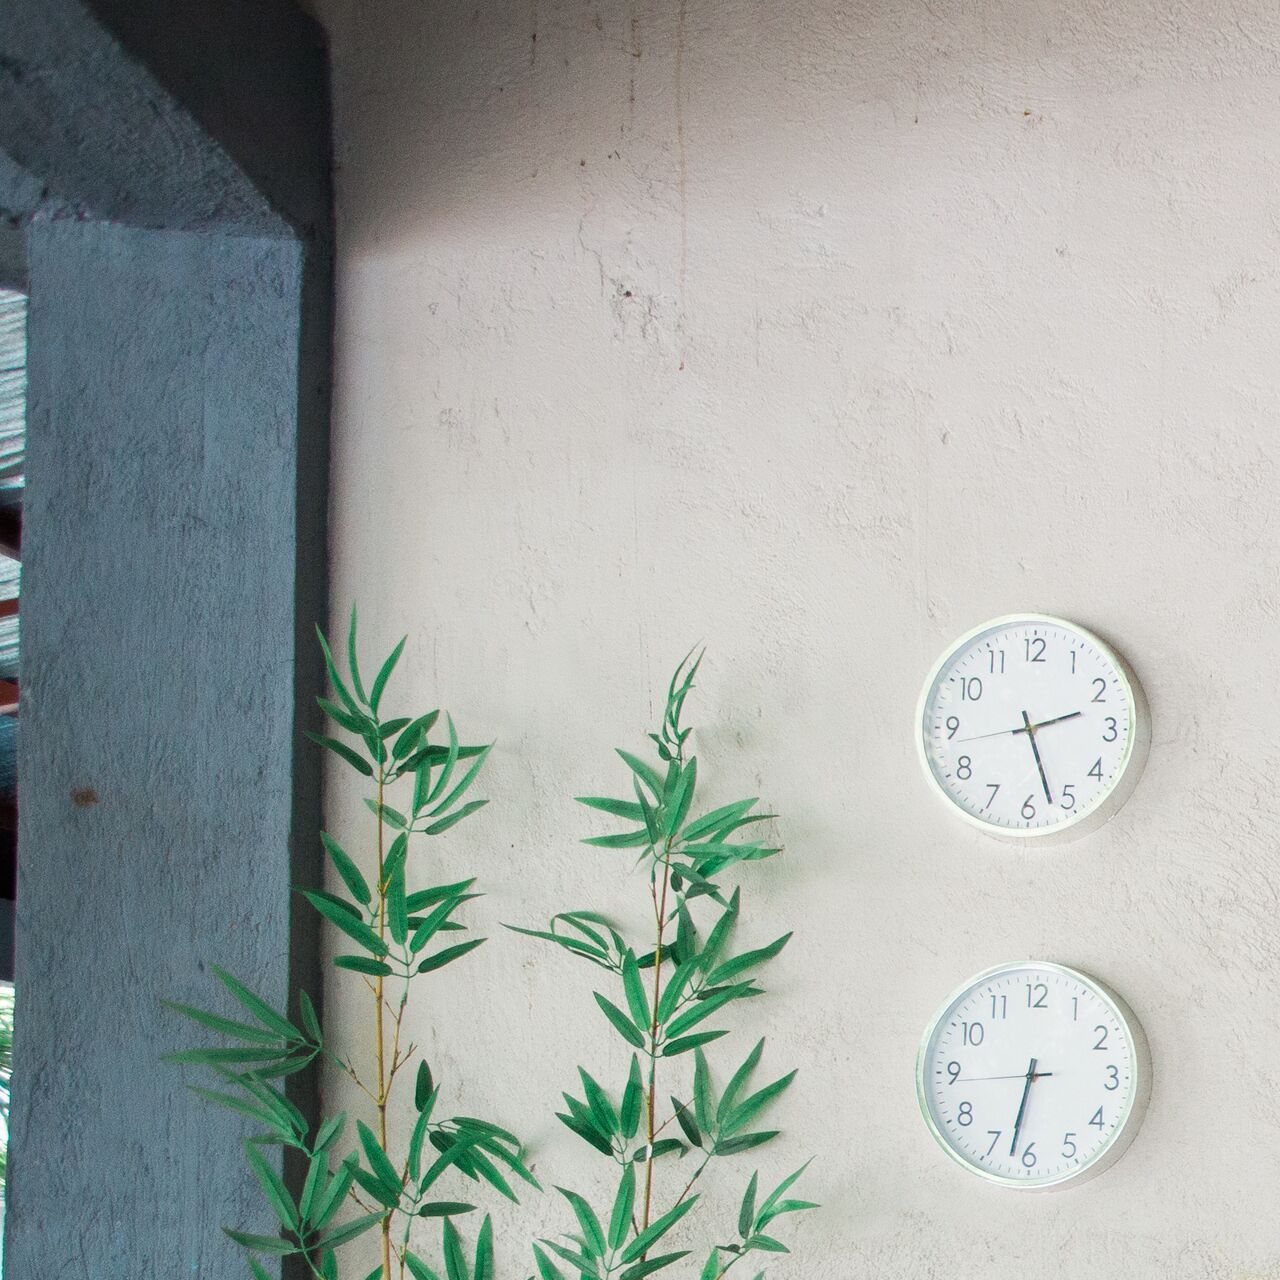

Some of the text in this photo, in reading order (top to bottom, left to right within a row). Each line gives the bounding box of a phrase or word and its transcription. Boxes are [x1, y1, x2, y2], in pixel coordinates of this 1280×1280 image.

[989, 650, 1004, 673] 11
[1024, 638, 1046, 662] 12
[1070, 651, 1075, 674] 1
[961, 677, 982, 701] 10
[1091, 678, 1106, 702] 2
[946, 717, 960, 740] 9
[1103, 717, 1117, 742] 3
[957, 756, 972, 780] 8
[1087, 757, 1103, 781] 4
[986, 784, 1000, 809] 7
[1021, 795, 1035, 819] 6
[1061, 785, 1075, 809] 5
[991, 995, 1006, 1019] 11
[1026, 984, 1048, 1008] 12
[1072, 997, 1077, 1021] 1
[962, 1022, 984, 1046] 10
[1093, 1025, 1108, 1050] 2
[947, 1061, 961, 1085] 9
[1104, 1065, 1119, 1090] 3
[957, 1102, 972, 1126] 8
[1089, 1105, 1104, 1130] 4
[987, 1131, 1001, 1155] 7
[1022, 1142, 1036, 1167] 6
[1062, 1133, 1076, 1158] 5
